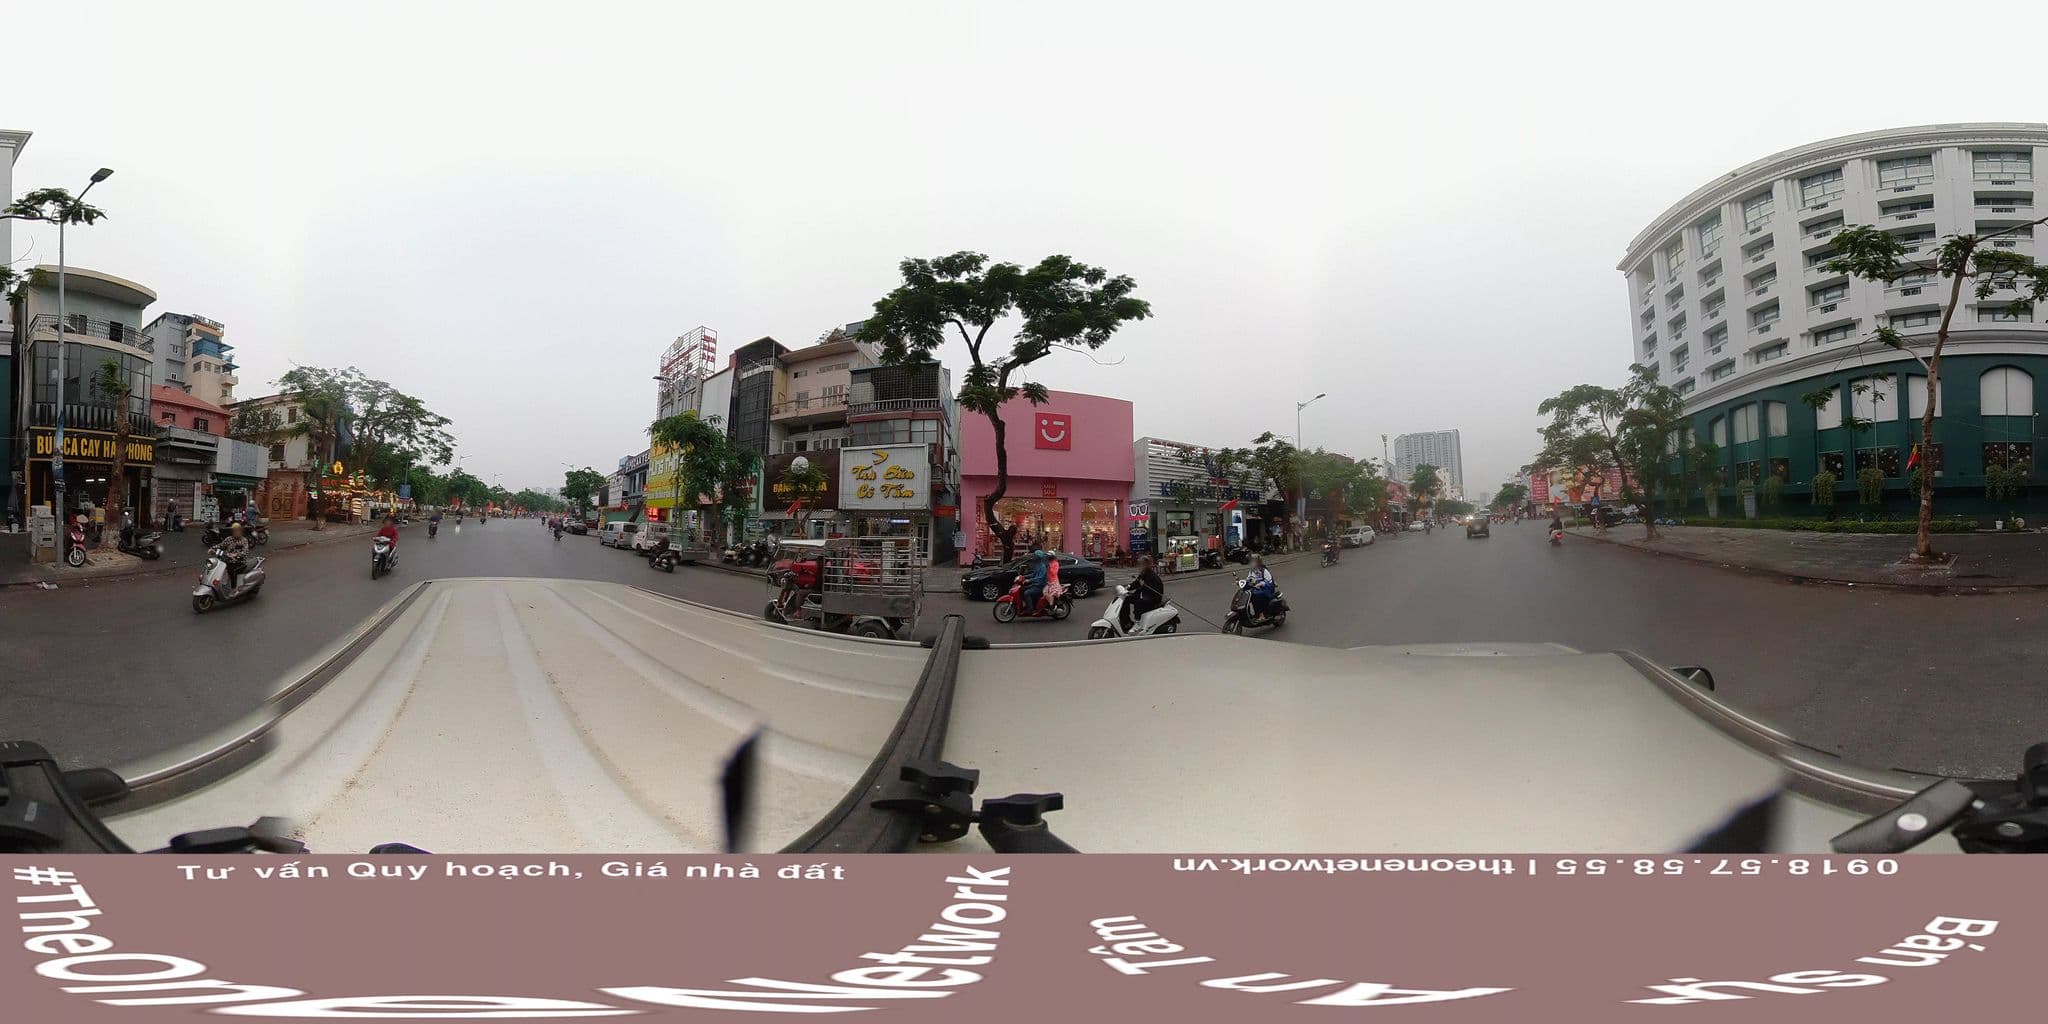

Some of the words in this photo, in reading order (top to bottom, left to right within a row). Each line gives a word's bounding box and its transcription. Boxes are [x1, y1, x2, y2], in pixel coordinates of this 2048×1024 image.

[37, 432, 57, 455] BÚ
[63, 433, 78, 456] CÁ
[81, 438, 100, 457] CAY
[103, 435, 117, 458] HẢ
